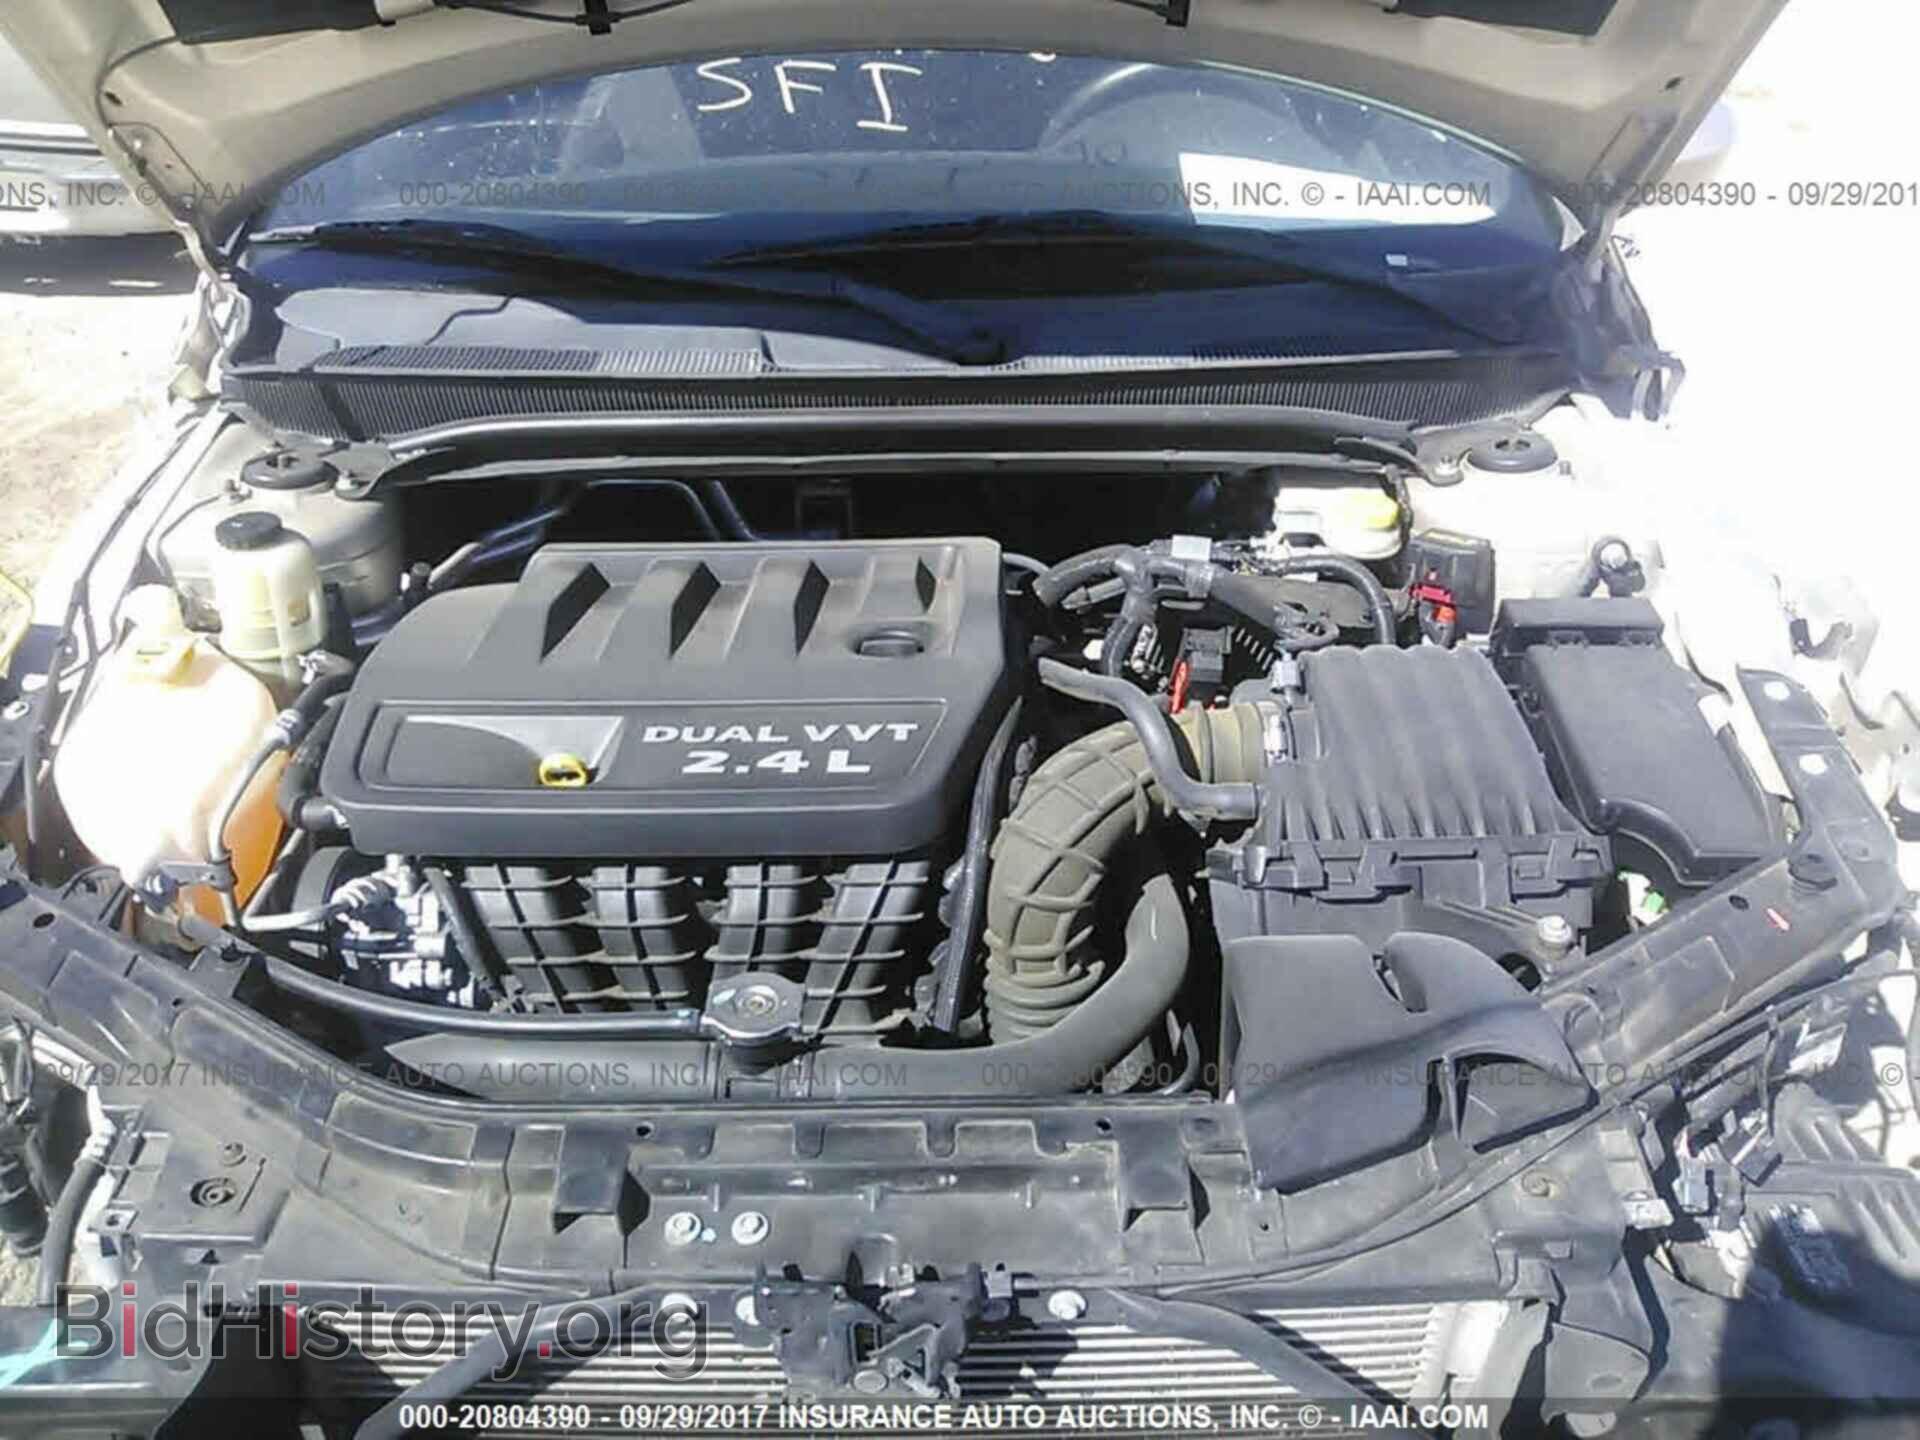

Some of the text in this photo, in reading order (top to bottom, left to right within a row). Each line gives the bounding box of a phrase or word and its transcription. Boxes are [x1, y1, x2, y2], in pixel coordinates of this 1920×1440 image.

[697, 57, 923, 132] SFI
[642, 723, 919, 743] DUAL VVT
